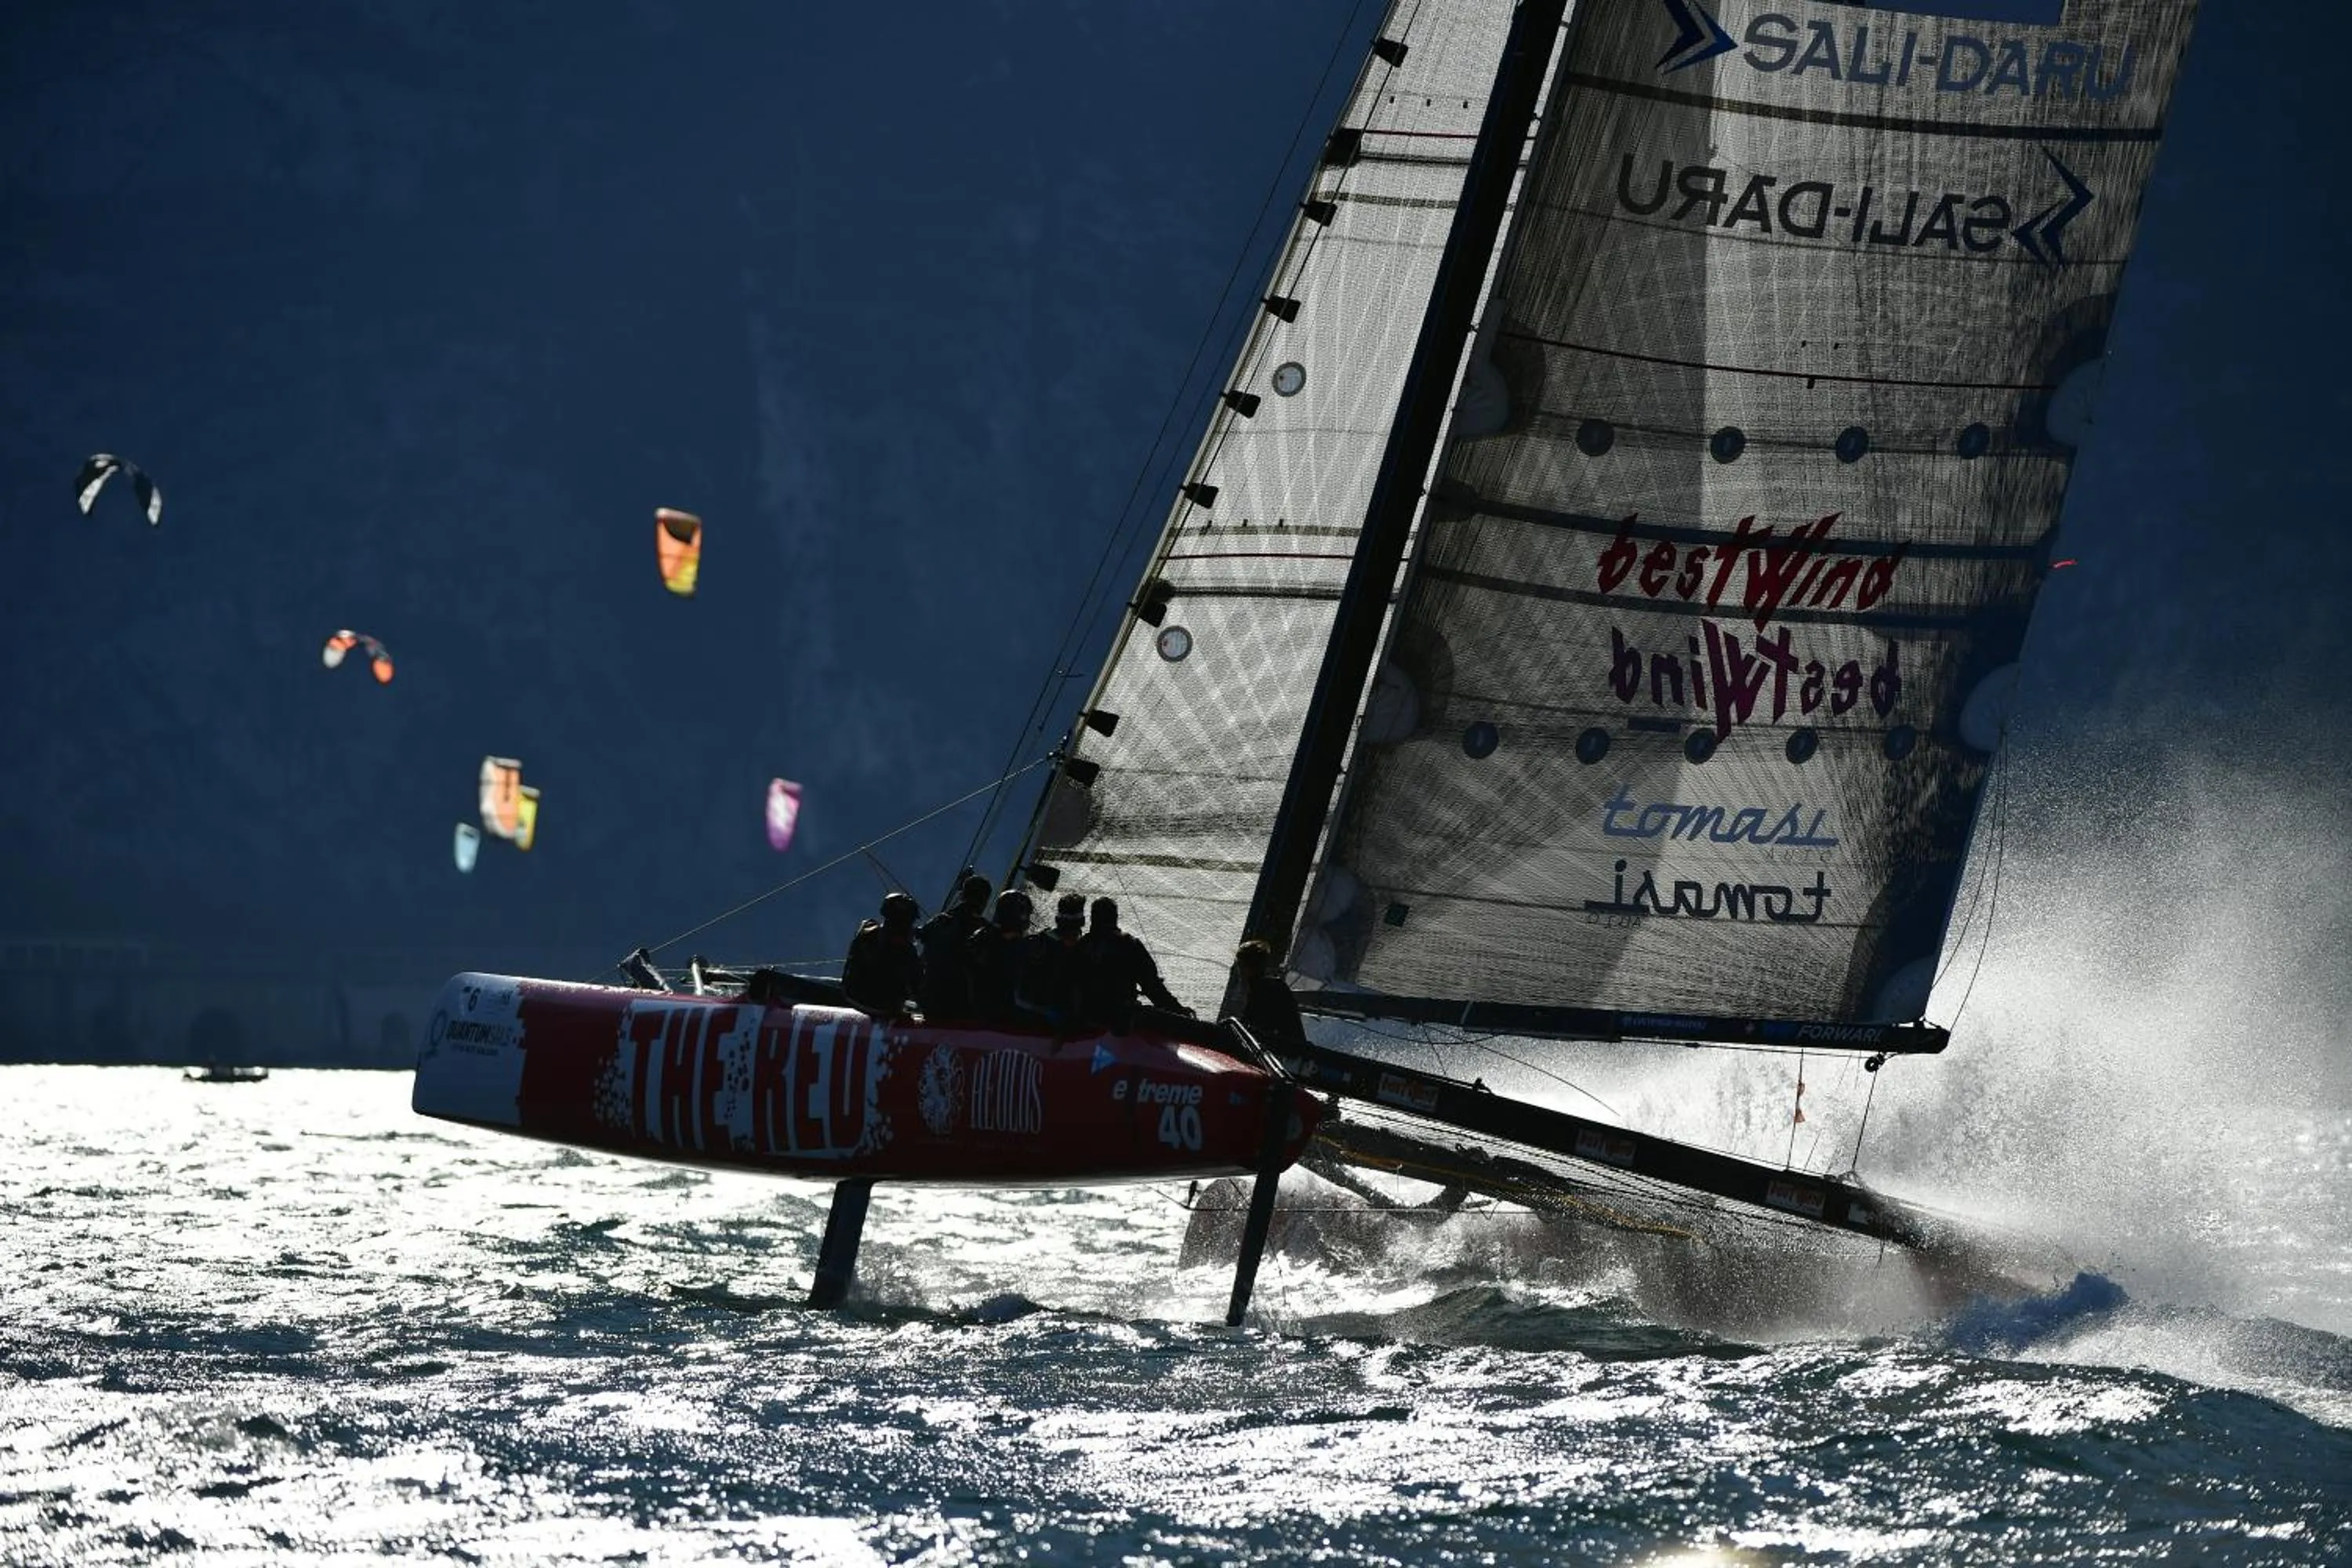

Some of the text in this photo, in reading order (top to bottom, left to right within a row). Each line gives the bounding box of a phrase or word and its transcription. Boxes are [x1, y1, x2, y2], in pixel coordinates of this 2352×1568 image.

[1743, 13, 2133, 100] SALI-DARU
[629, 1007, 739, 1153] THE
[1112, 1078, 1203, 1105] etreme
[1158, 1105, 1203, 1152] 40
